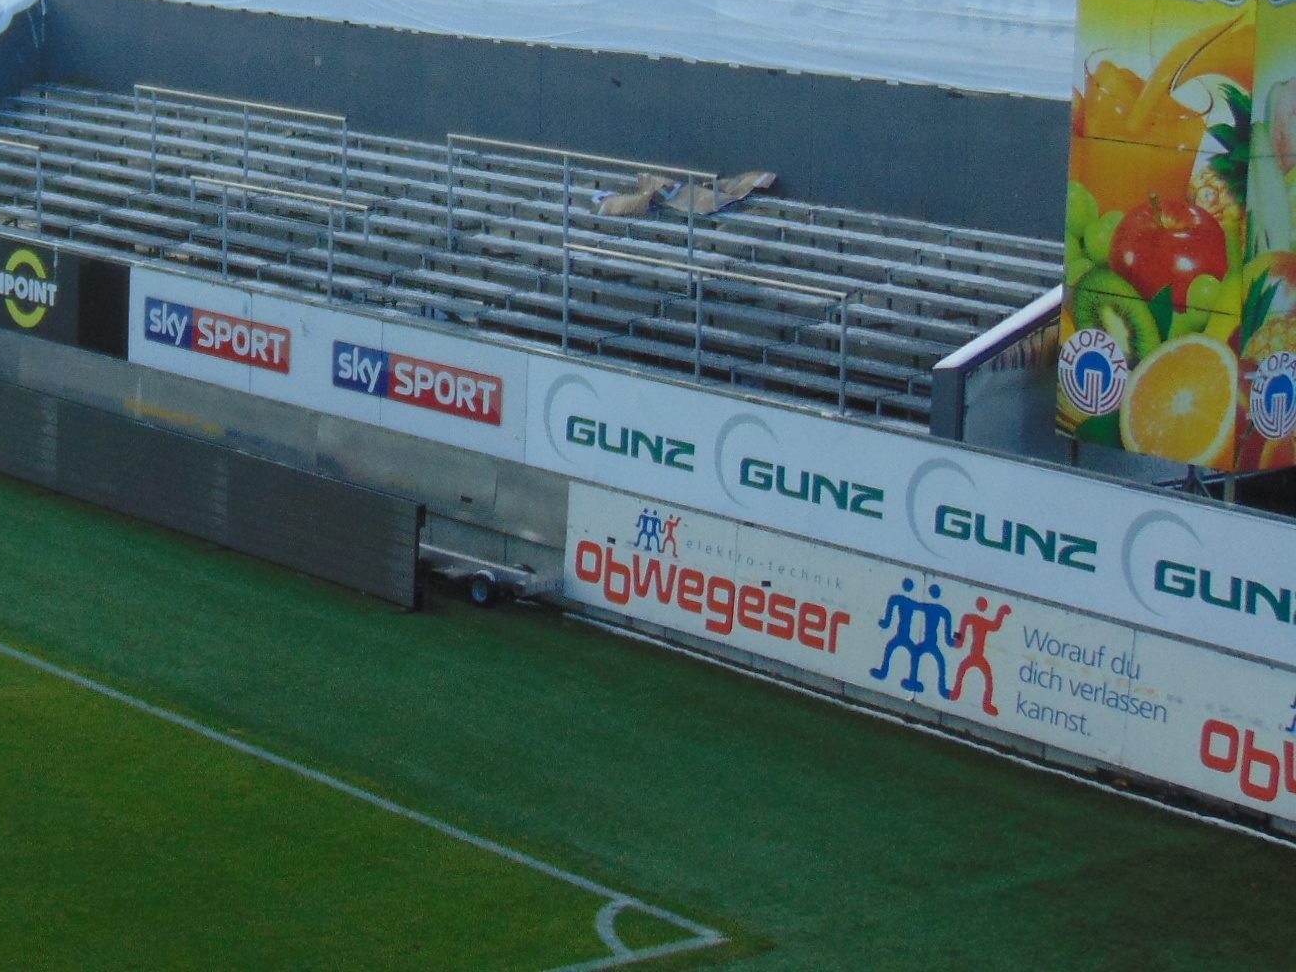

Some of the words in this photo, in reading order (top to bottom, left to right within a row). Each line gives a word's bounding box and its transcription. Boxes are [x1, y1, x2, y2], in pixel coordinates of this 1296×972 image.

[149, 302, 189, 346] sky
[196, 316, 287, 365] SPORT
[1061, 329, 1128, 374] ELOPAK
[337, 345, 383, 393] sky
[394, 363, 497, 416] SPORT
[565, 415, 696, 473] GUNZ
[739, 457, 885, 520] GUNZ
[935, 504, 1098, 574] GUNZ
[575, 540, 851, 655] obwegeser
[1154, 559, 1296, 627] GUN
[1023, 625, 1107, 669] Worauf
[1110, 652, 1142, 680] du
[1015, 691, 1092, 737] kannst.
[1018, 659, 1063, 693] dich
[1068, 677, 1169, 724] verlassen
